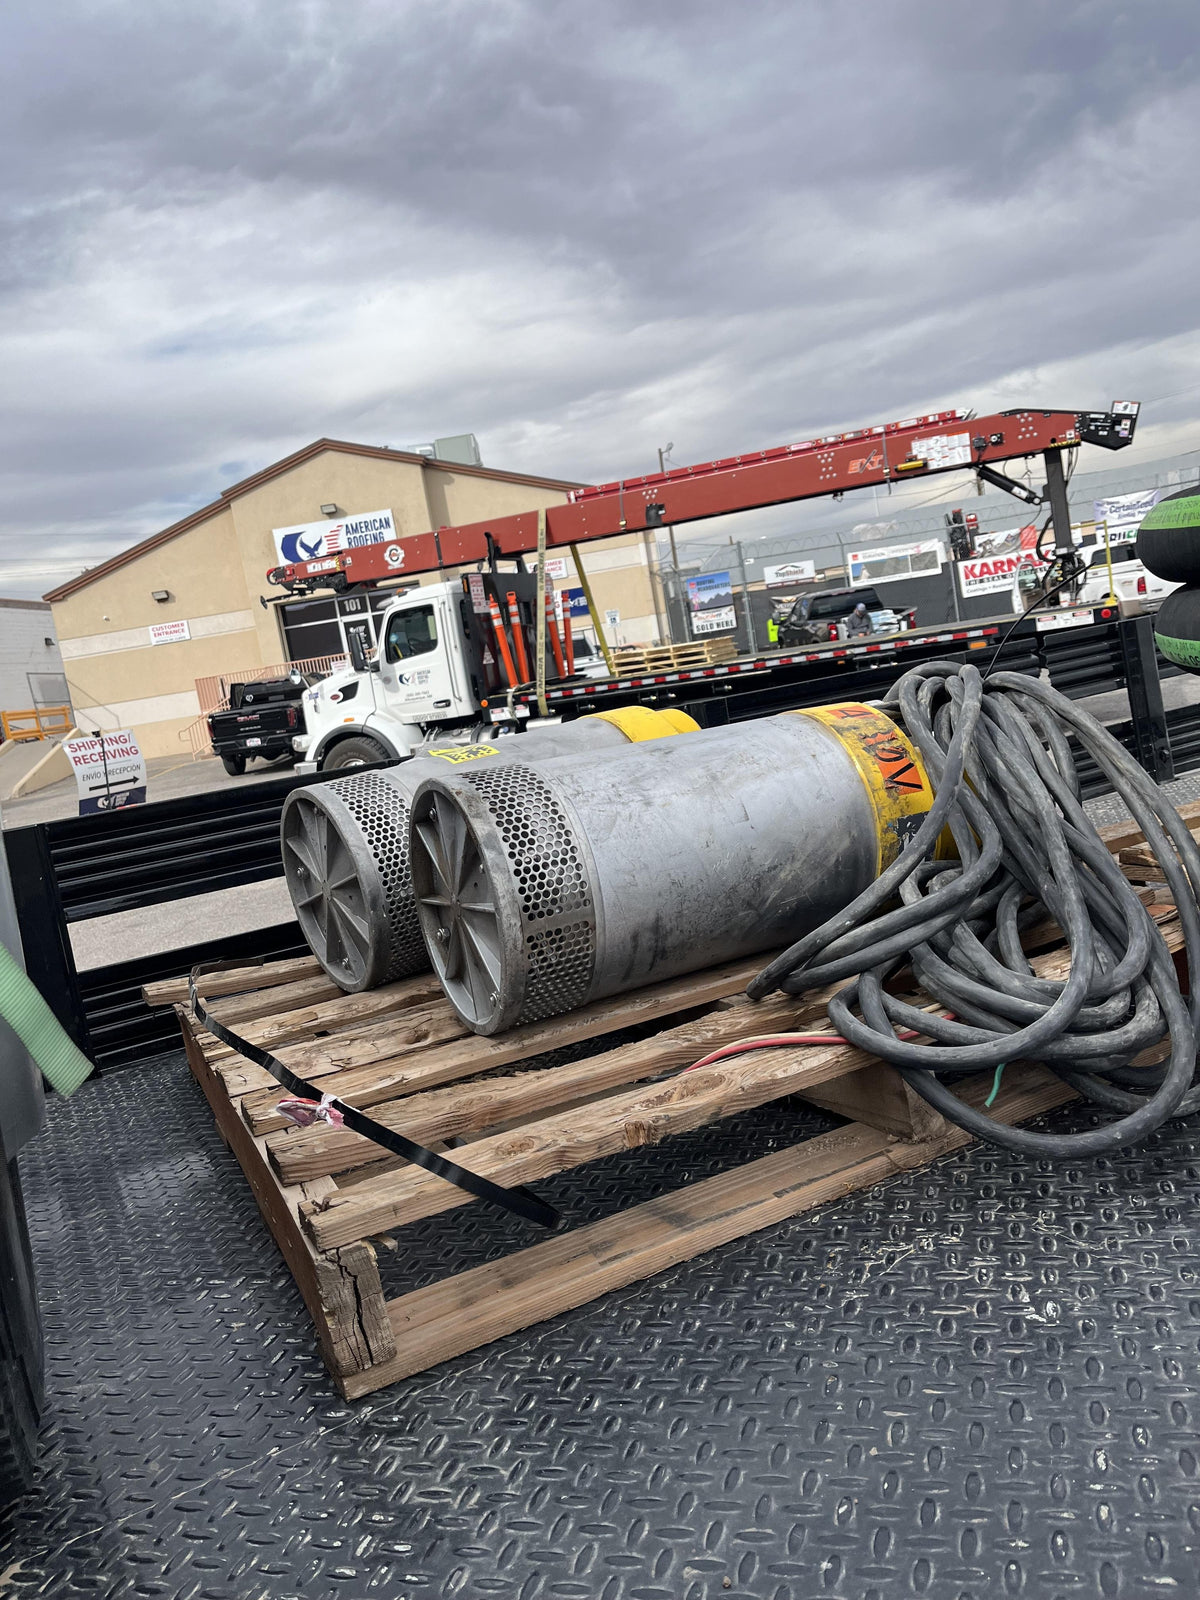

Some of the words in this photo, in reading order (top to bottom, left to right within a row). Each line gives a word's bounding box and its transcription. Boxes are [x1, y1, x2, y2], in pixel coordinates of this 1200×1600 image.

[345, 517, 391, 536] AMERICAN
[347, 531, 385, 549] ROOFING
[344, 598, 361, 612] 101
[152, 623, 185, 632] CUSTOMER
[154, 629, 185, 638] ENTRANCE
[696, 622, 715, 632] SOLD
[717, 620, 734, 630] HERE
[68, 733, 132, 753] SHIPPING/
[72, 745, 139, 767] RECEIVING
